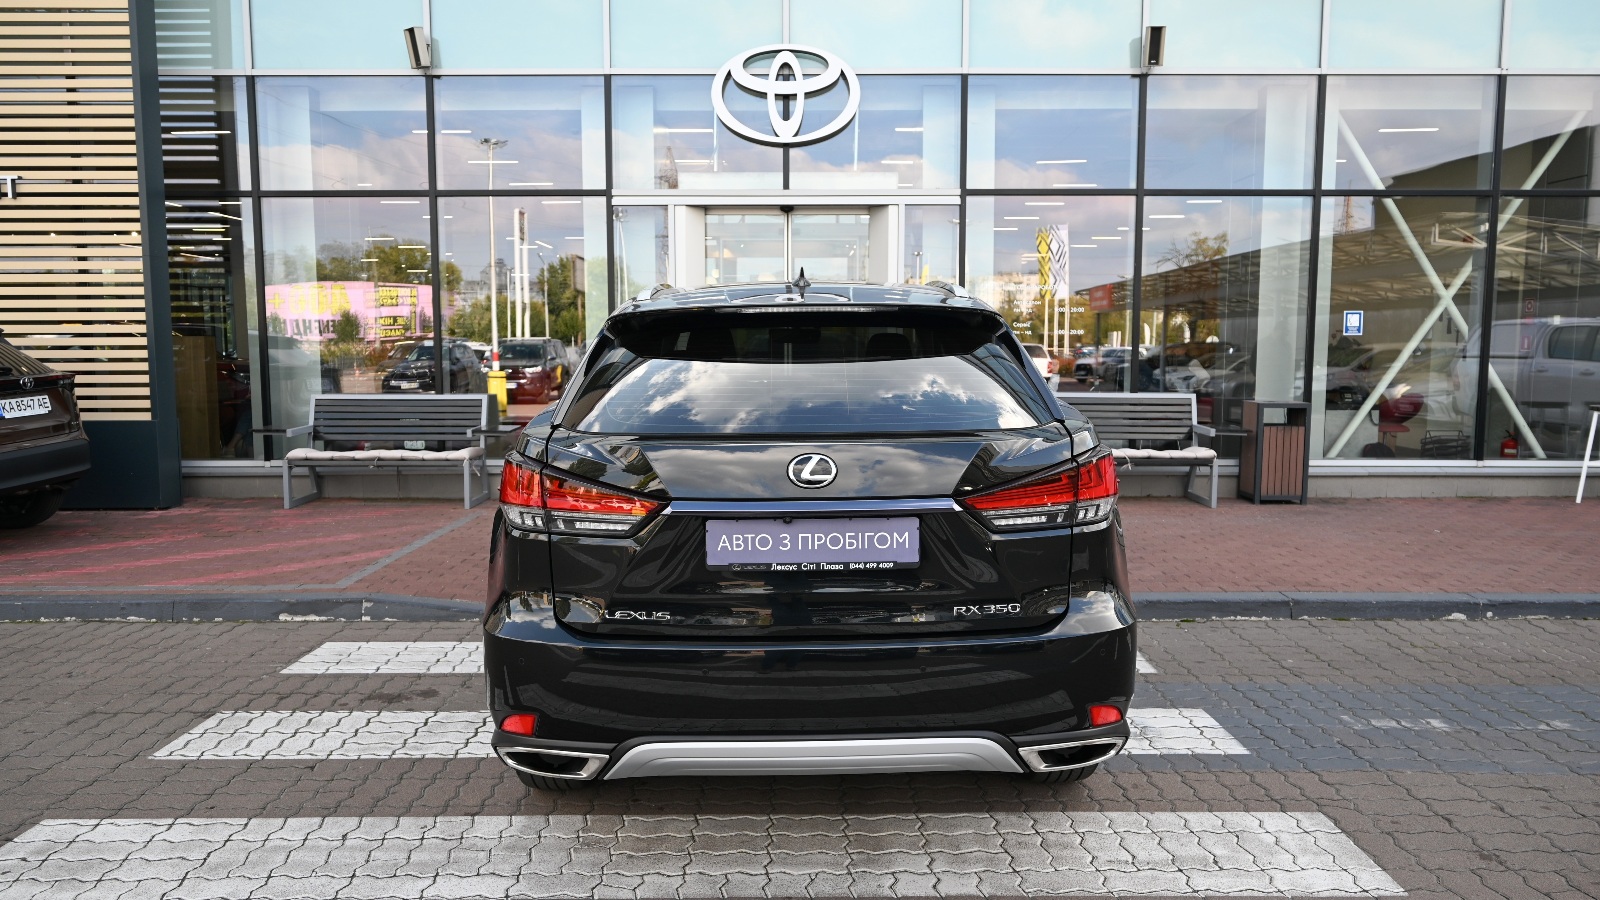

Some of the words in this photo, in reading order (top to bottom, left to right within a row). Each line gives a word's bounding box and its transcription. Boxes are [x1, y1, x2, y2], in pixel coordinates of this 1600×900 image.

[0, 402, 16, 413] KA
[16, 398, 35, 412] 8547
[37, 397, 50, 410] AE
[717, 533, 773, 551] АВТО
[779, 533, 791, 551] З
[798, 531, 909, 550] ПРОБІГОМ
[771, 563, 798, 571] Лексус
[801, 562, 816, 571] Сіті
[820, 562, 844, 570] Плаза
[849, 561, 865, 570] (044)
[605, 610, 671, 621] LEXUS
